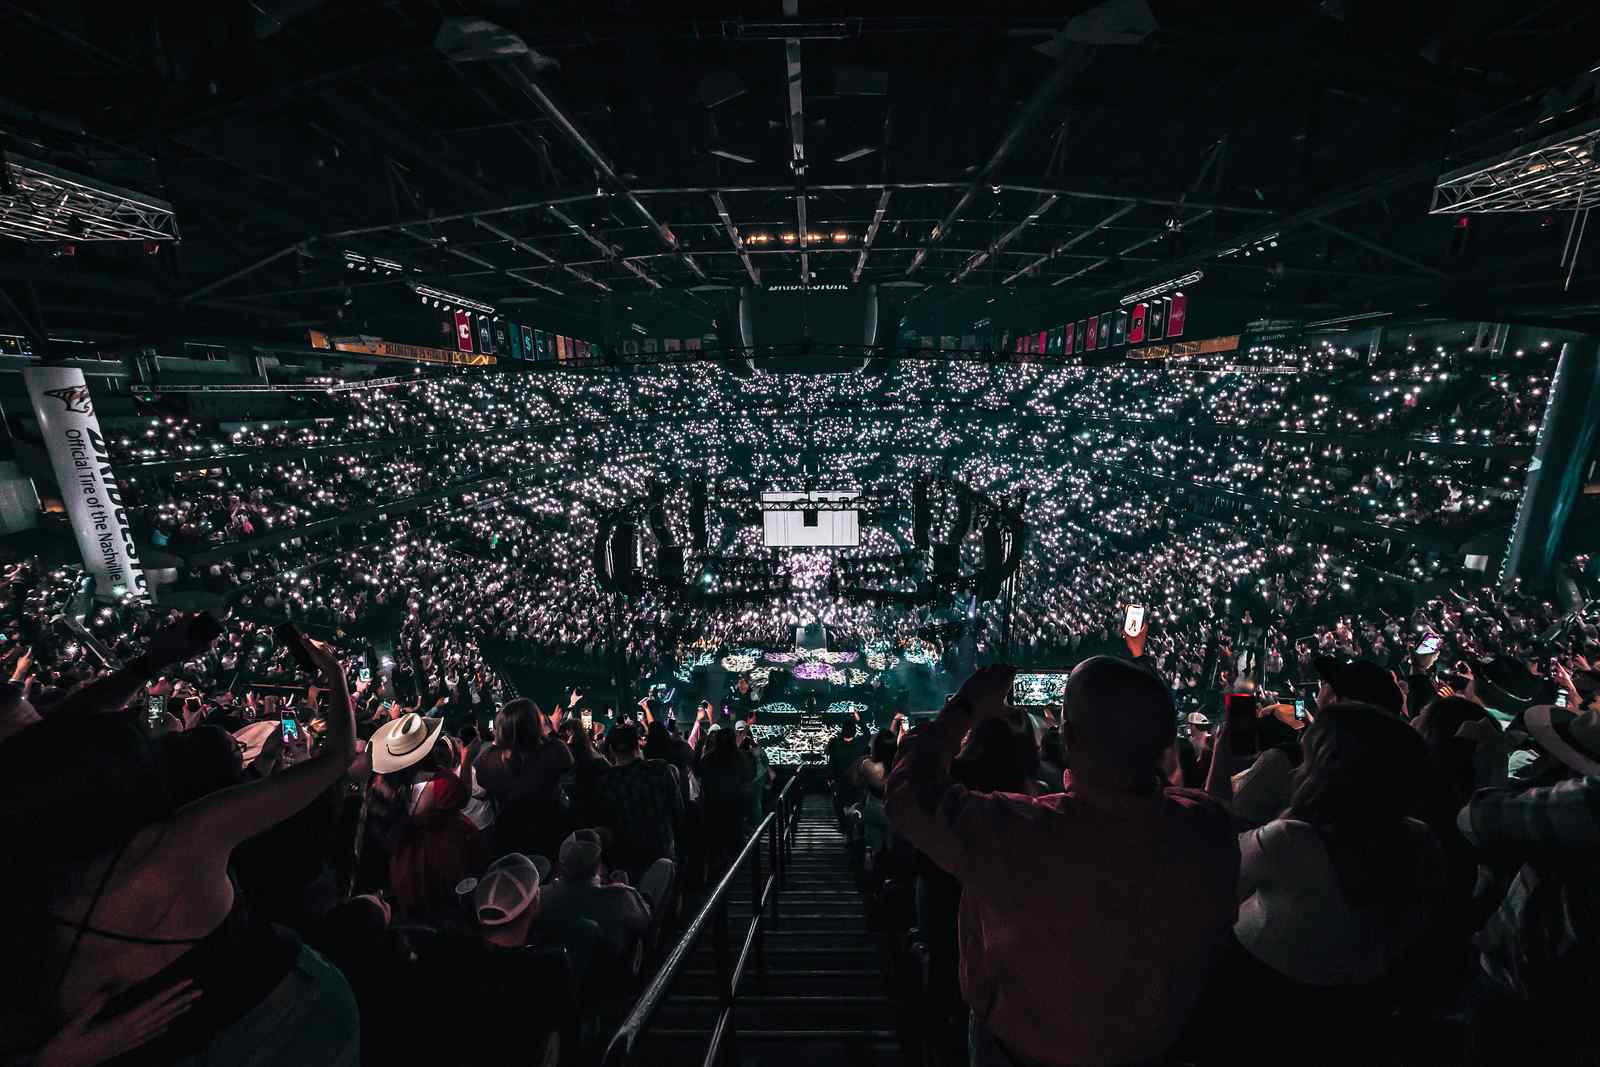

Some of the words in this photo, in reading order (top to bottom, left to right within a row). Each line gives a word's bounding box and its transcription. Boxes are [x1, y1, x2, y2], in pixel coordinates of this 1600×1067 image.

[65, 428, 91, 472] Official
[79, 472, 96, 495] Tire
[86, 427, 152, 603] BRIDGESTO
[87, 496, 104, 510] of
[92, 509, 108, 531] the
[98, 532, 123, 581] Nashville
